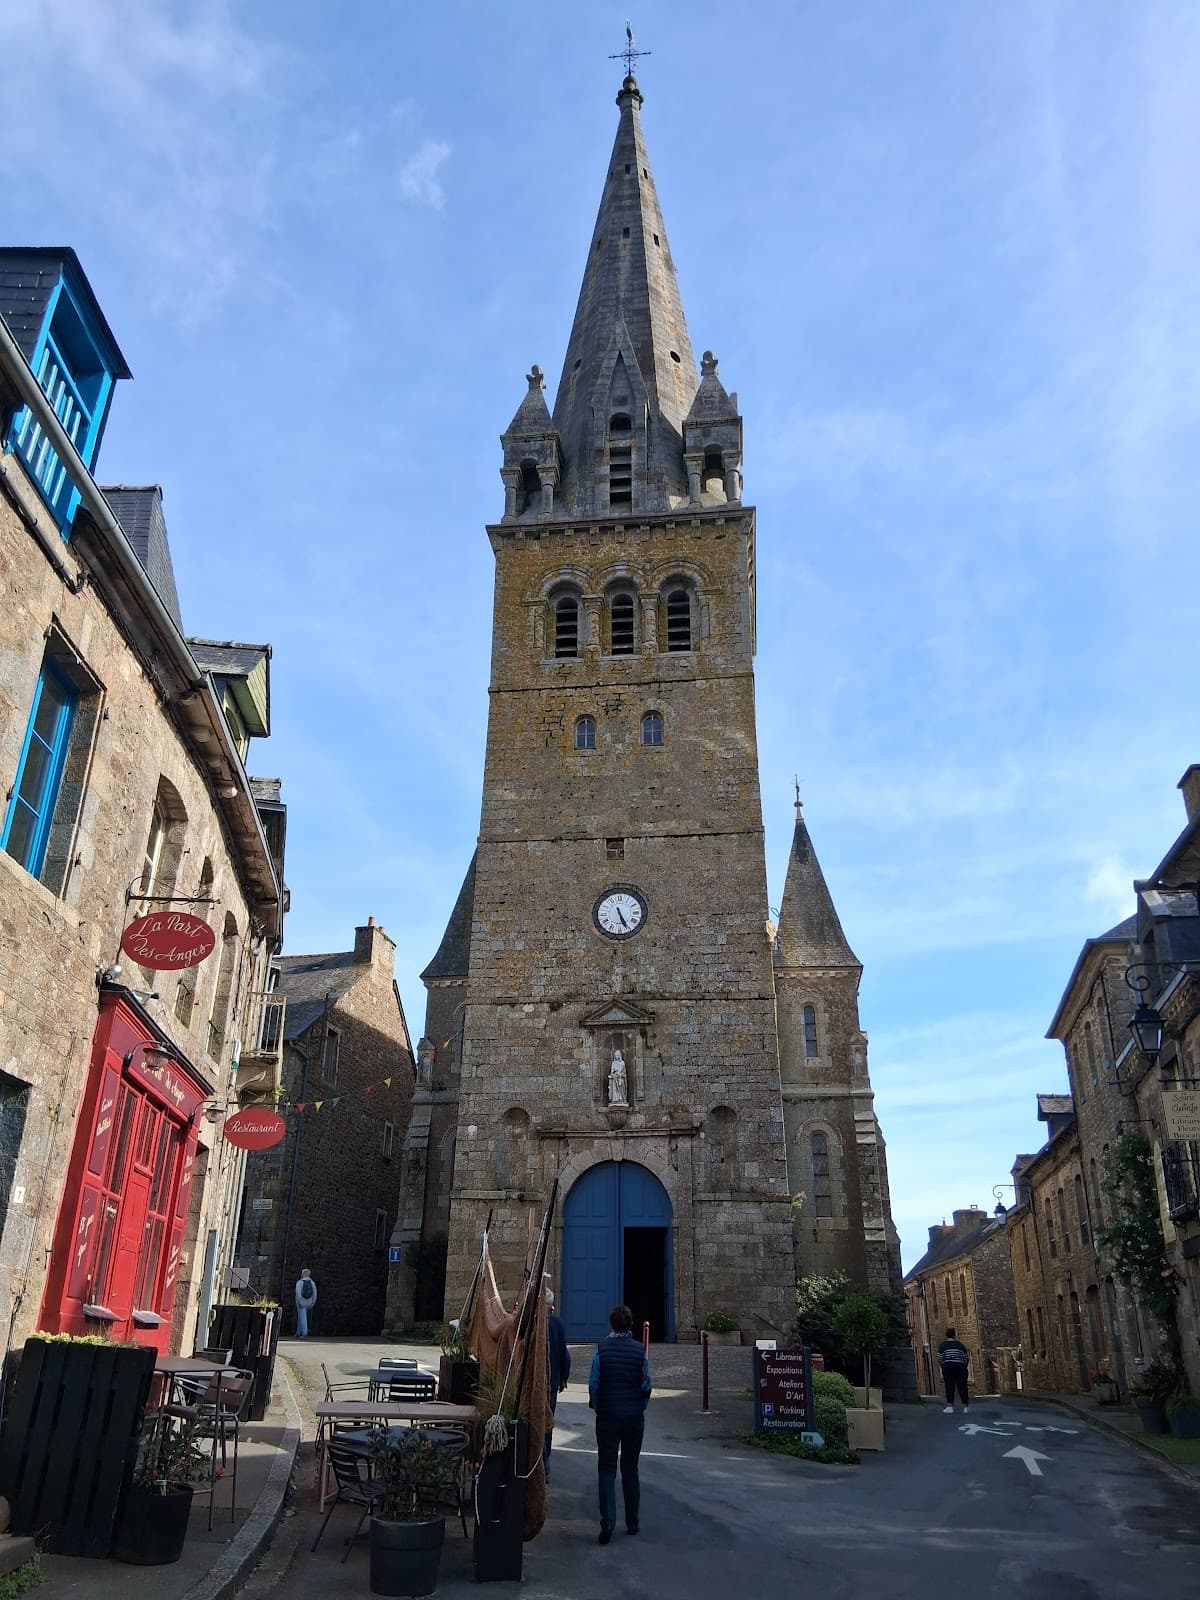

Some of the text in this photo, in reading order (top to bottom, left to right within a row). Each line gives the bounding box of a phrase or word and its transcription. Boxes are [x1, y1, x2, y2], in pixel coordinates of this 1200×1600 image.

[130, 914, 208, 940] La Part
[155, 943, 212, 968] Anges
[225, 1120, 284, 1133] Restaurant
[775, 1351, 803, 1362] Librairie
[766, 1365, 803, 1376] Expositions
[778, 1379, 804, 1389] Ateliers
[786, 1391, 804, 1401] D'Art
[779, 1405, 805, 1417] Parking
[763, 1417, 806, 1428] Restauration
